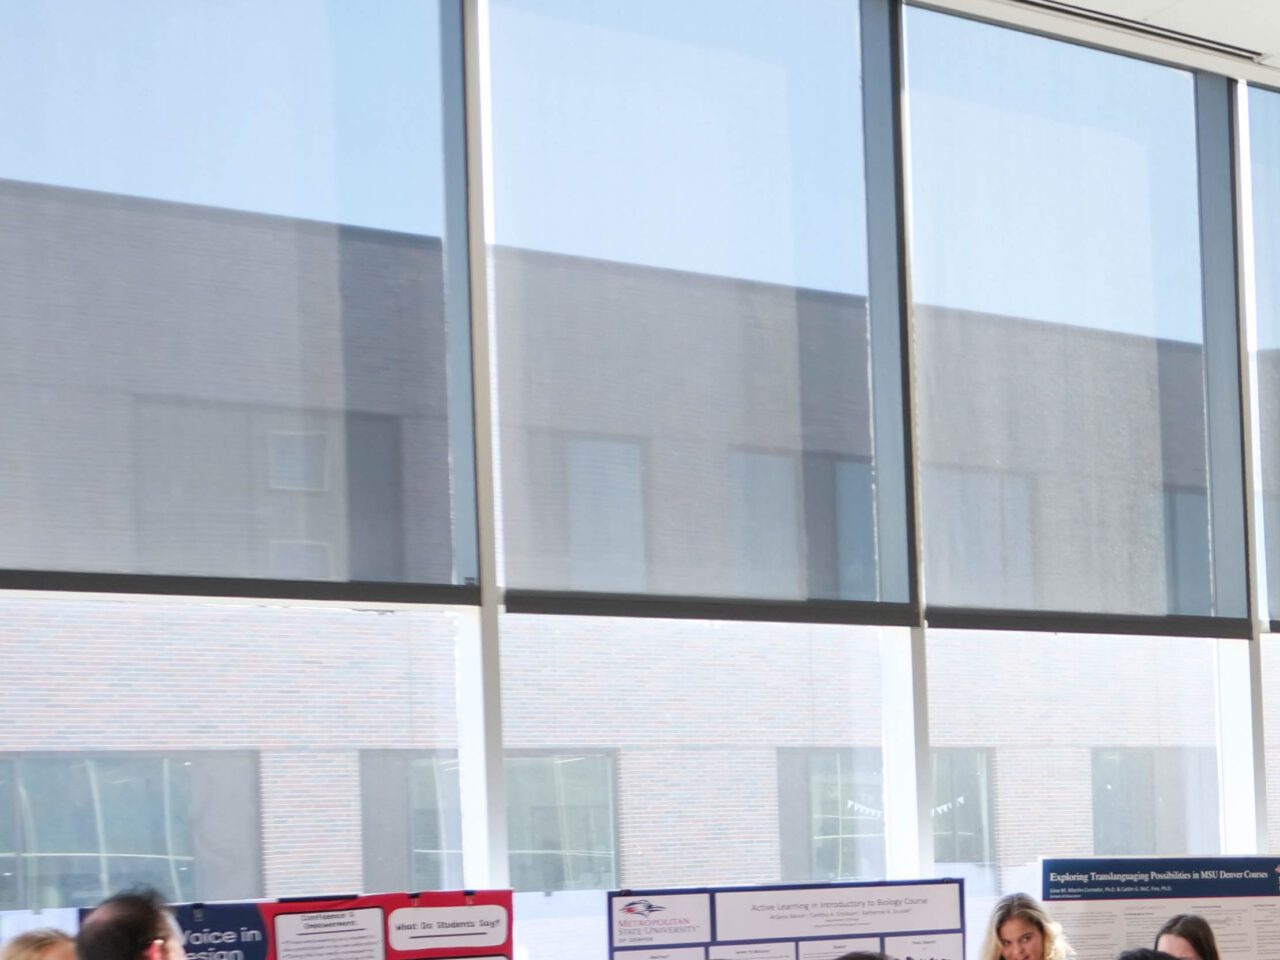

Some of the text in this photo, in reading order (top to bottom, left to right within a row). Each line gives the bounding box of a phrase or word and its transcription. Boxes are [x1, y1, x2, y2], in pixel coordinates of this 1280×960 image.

[1050, 869, 1268, 883] Exploring Translanguaging Possibilities in MSU Denver Courses
[777, 903, 809, 911] Learning
[820, 900, 865, 909] Introductory
[877, 898, 902, 906] Biology
[396, 918, 501, 931] What Do Students Say?
[618, 917, 690, 928] METROPOLITAN
[240, 926, 263, 942] in
